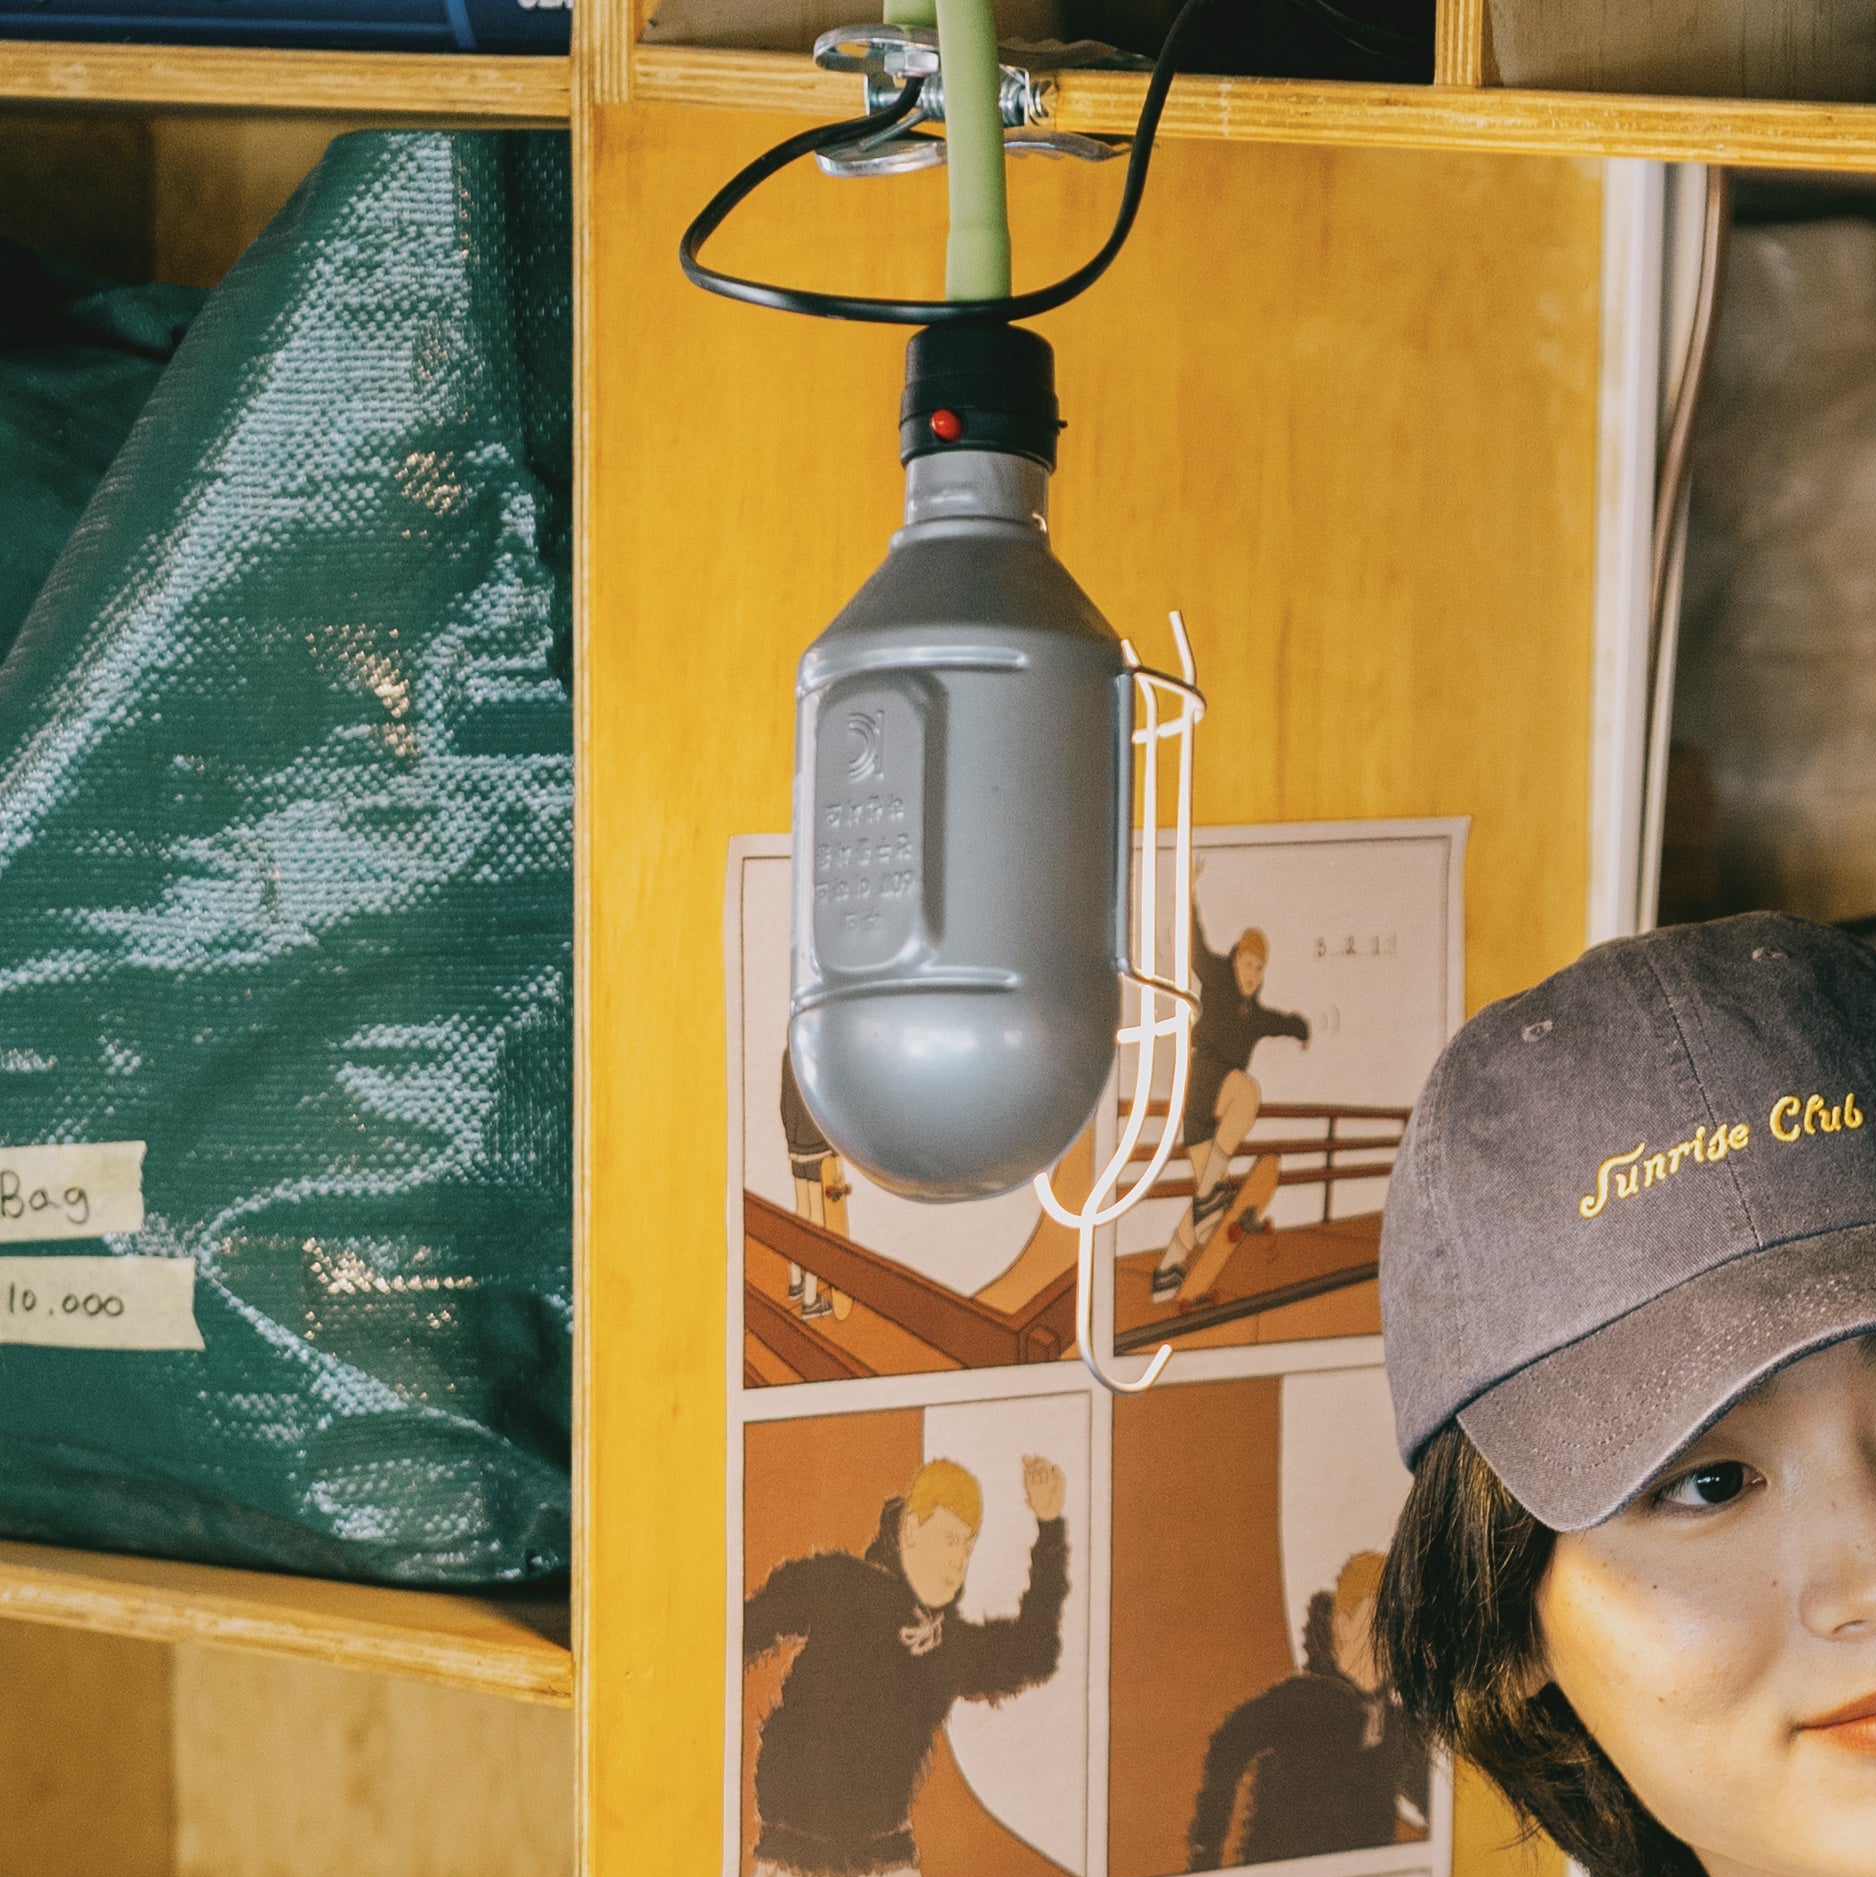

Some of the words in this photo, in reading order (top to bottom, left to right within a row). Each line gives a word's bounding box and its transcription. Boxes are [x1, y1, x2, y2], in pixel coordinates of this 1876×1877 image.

[0, 1170, 90, 1224] Bag
[1579, 1123, 1751, 1219] Sunrise
[1770, 1093, 1865, 1142] Club
